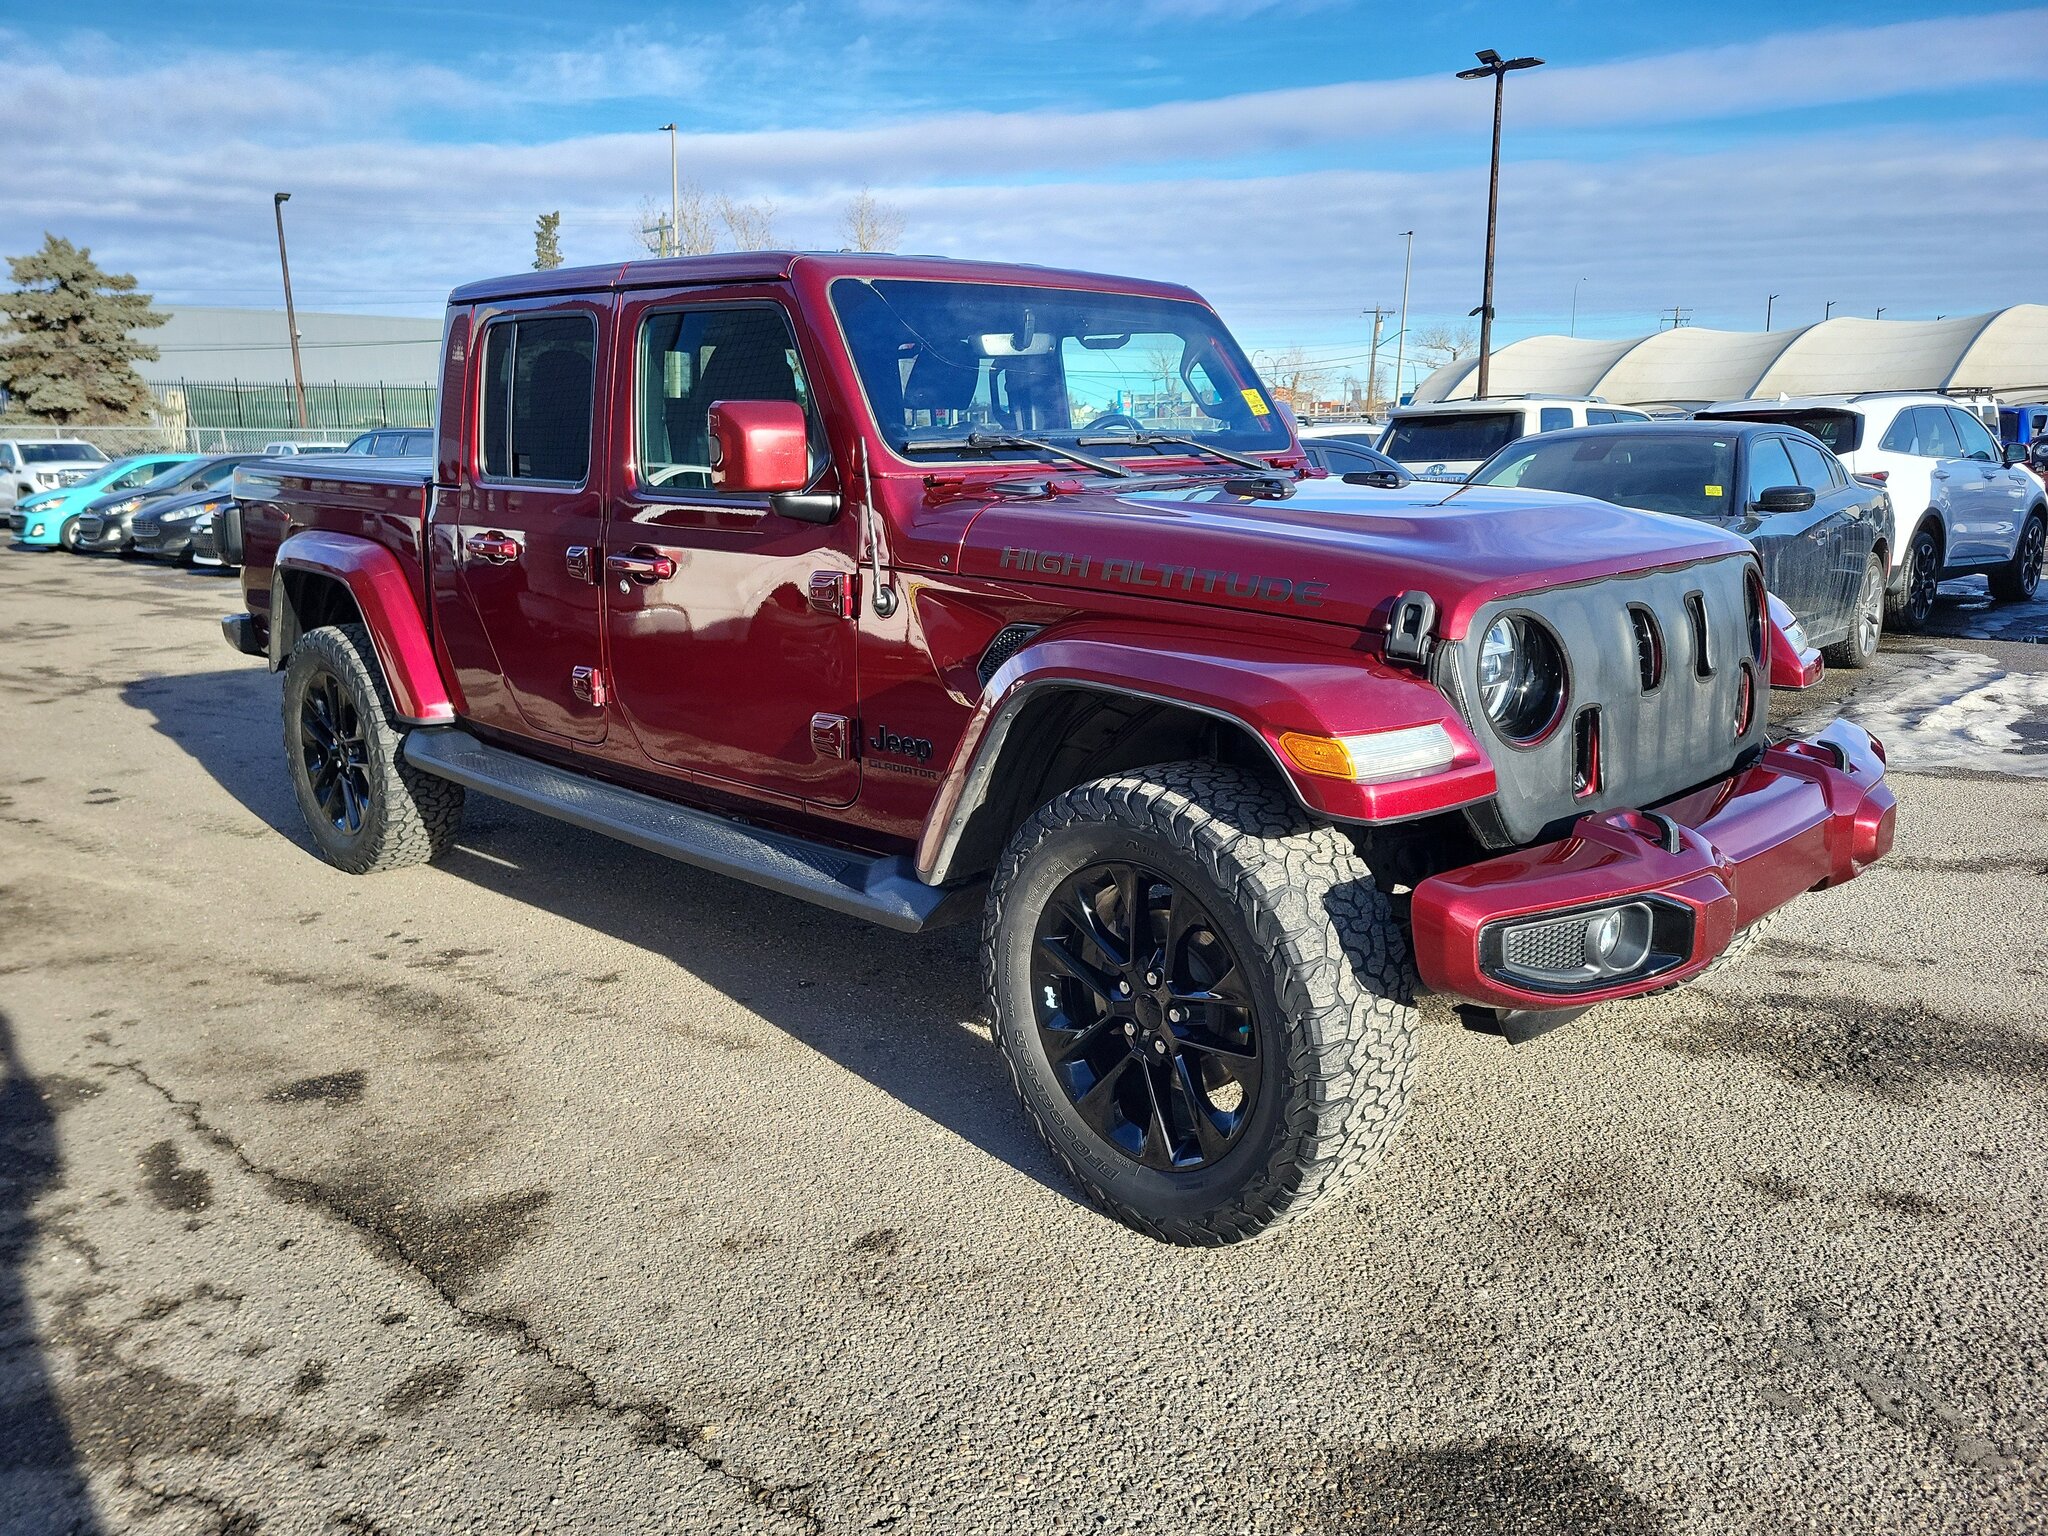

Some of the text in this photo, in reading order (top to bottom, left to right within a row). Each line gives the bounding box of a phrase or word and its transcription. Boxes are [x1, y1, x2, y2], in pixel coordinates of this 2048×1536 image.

[1000, 545, 1330, 607] HIGH ALTITUDE
[870, 725, 933, 764] Jeep
[869, 760, 937, 780] GLADIATOR
